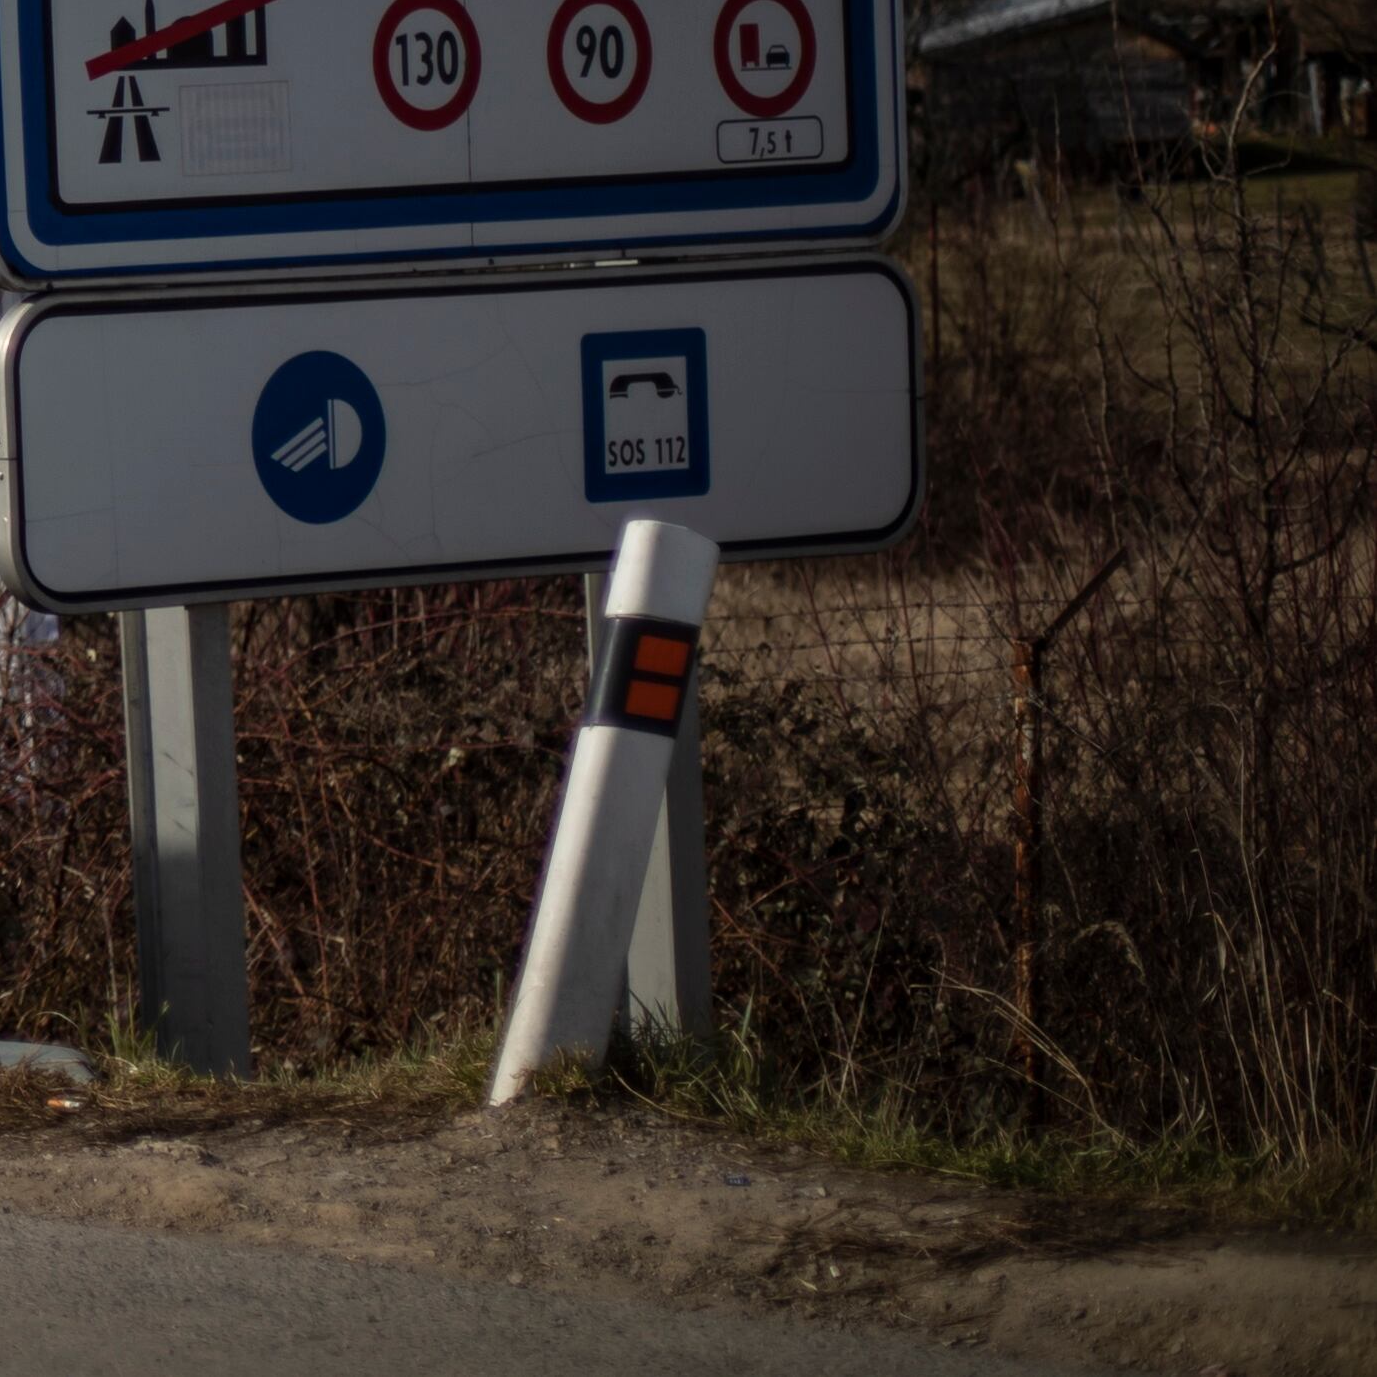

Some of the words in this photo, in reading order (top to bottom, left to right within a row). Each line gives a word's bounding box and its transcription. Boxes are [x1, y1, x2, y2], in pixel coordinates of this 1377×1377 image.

[395, 30, 459, 87] 130
[575, 25, 625, 80] 90
[749, 127, 777, 159] 7,5
[784, 129, 793, 154] t
[608, 438, 646, 466] SOS
[655, 435, 686, 464] 112
